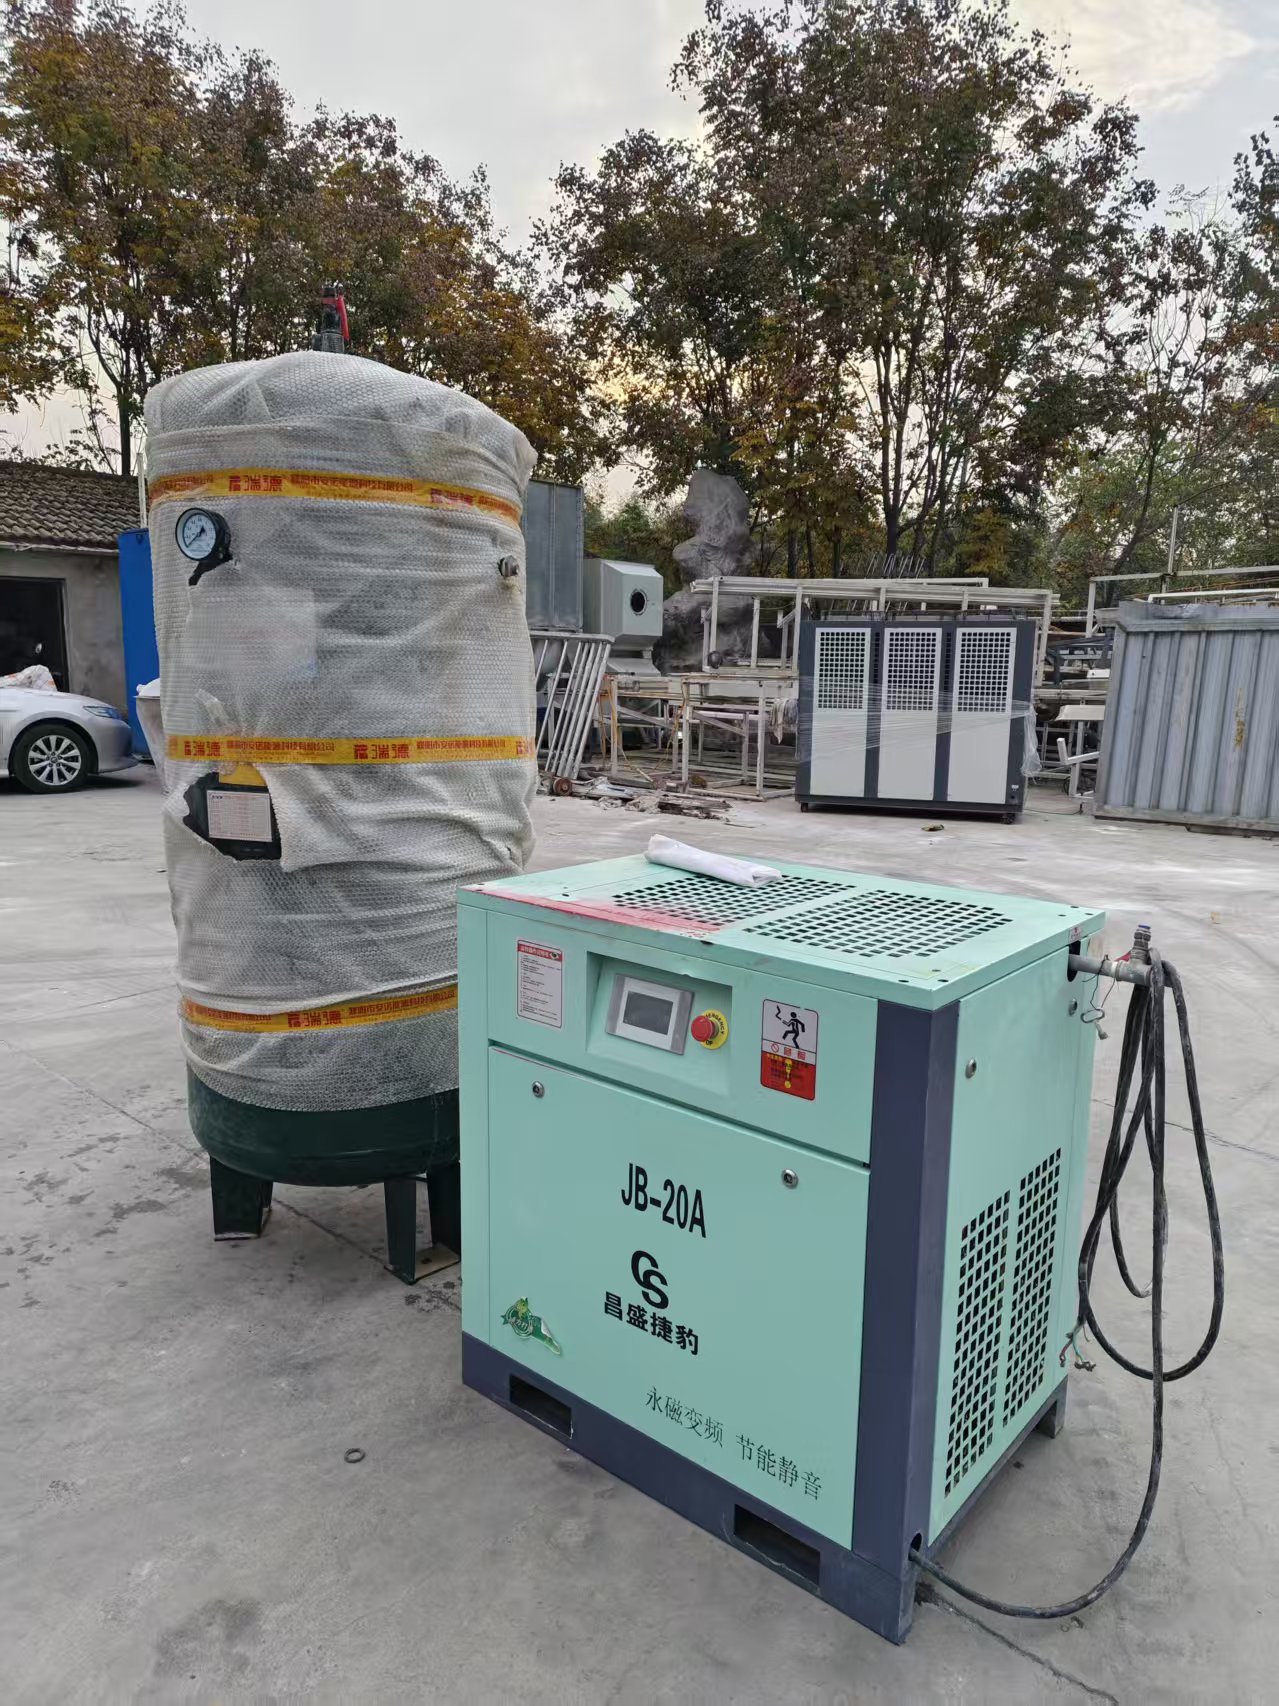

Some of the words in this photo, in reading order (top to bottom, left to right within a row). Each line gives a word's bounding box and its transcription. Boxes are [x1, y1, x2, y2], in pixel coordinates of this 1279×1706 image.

[621, 1163, 706, 1238] JB-20A
[604, 1291, 699, 1356] 昌盛捷豹
[645, 1386, 724, 1448] 永磁变频
[735, 1434, 822, 1501] 节能静音
